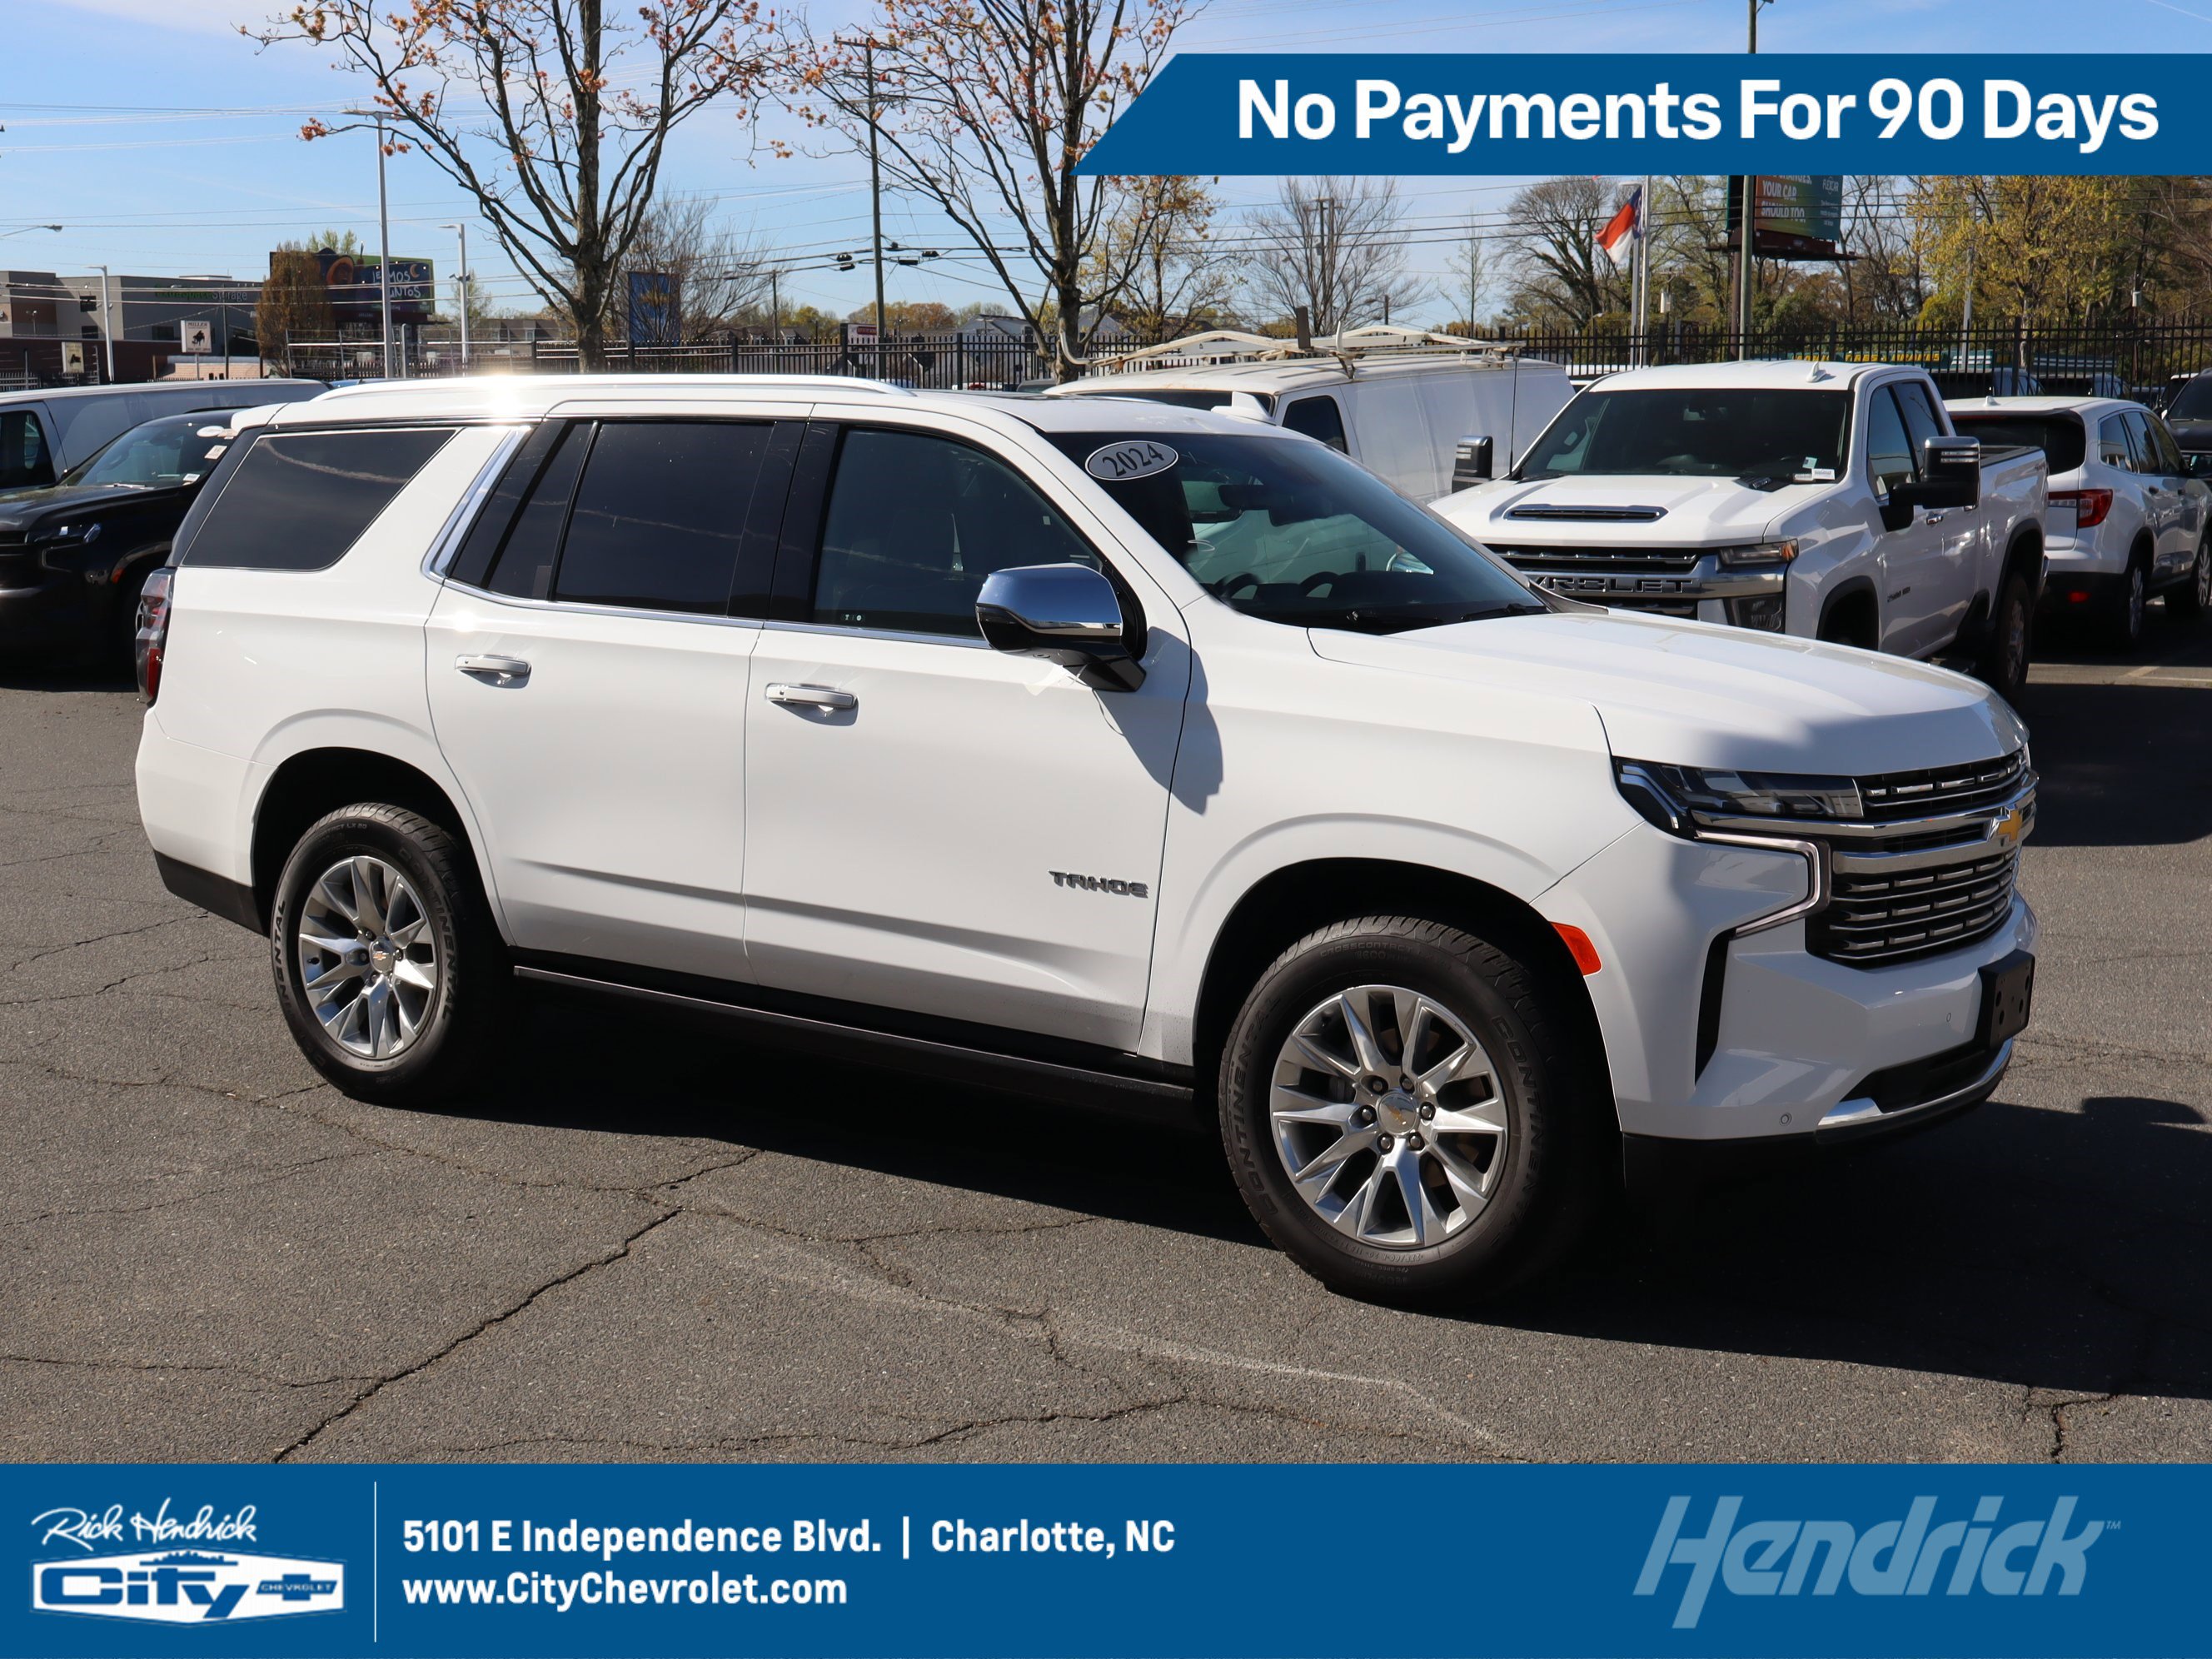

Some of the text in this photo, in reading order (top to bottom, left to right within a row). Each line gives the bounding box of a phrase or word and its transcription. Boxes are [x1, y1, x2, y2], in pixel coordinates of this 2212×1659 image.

[1762, 180, 1797, 201] YOUR CAR
[1761, 201, 1790, 218] SHOULD
[1102, 444, 1164, 476] 2024
[1048, 870, 1148, 899] TAHOE
[1234, 997, 1281, 1214] CONTINENTAL
